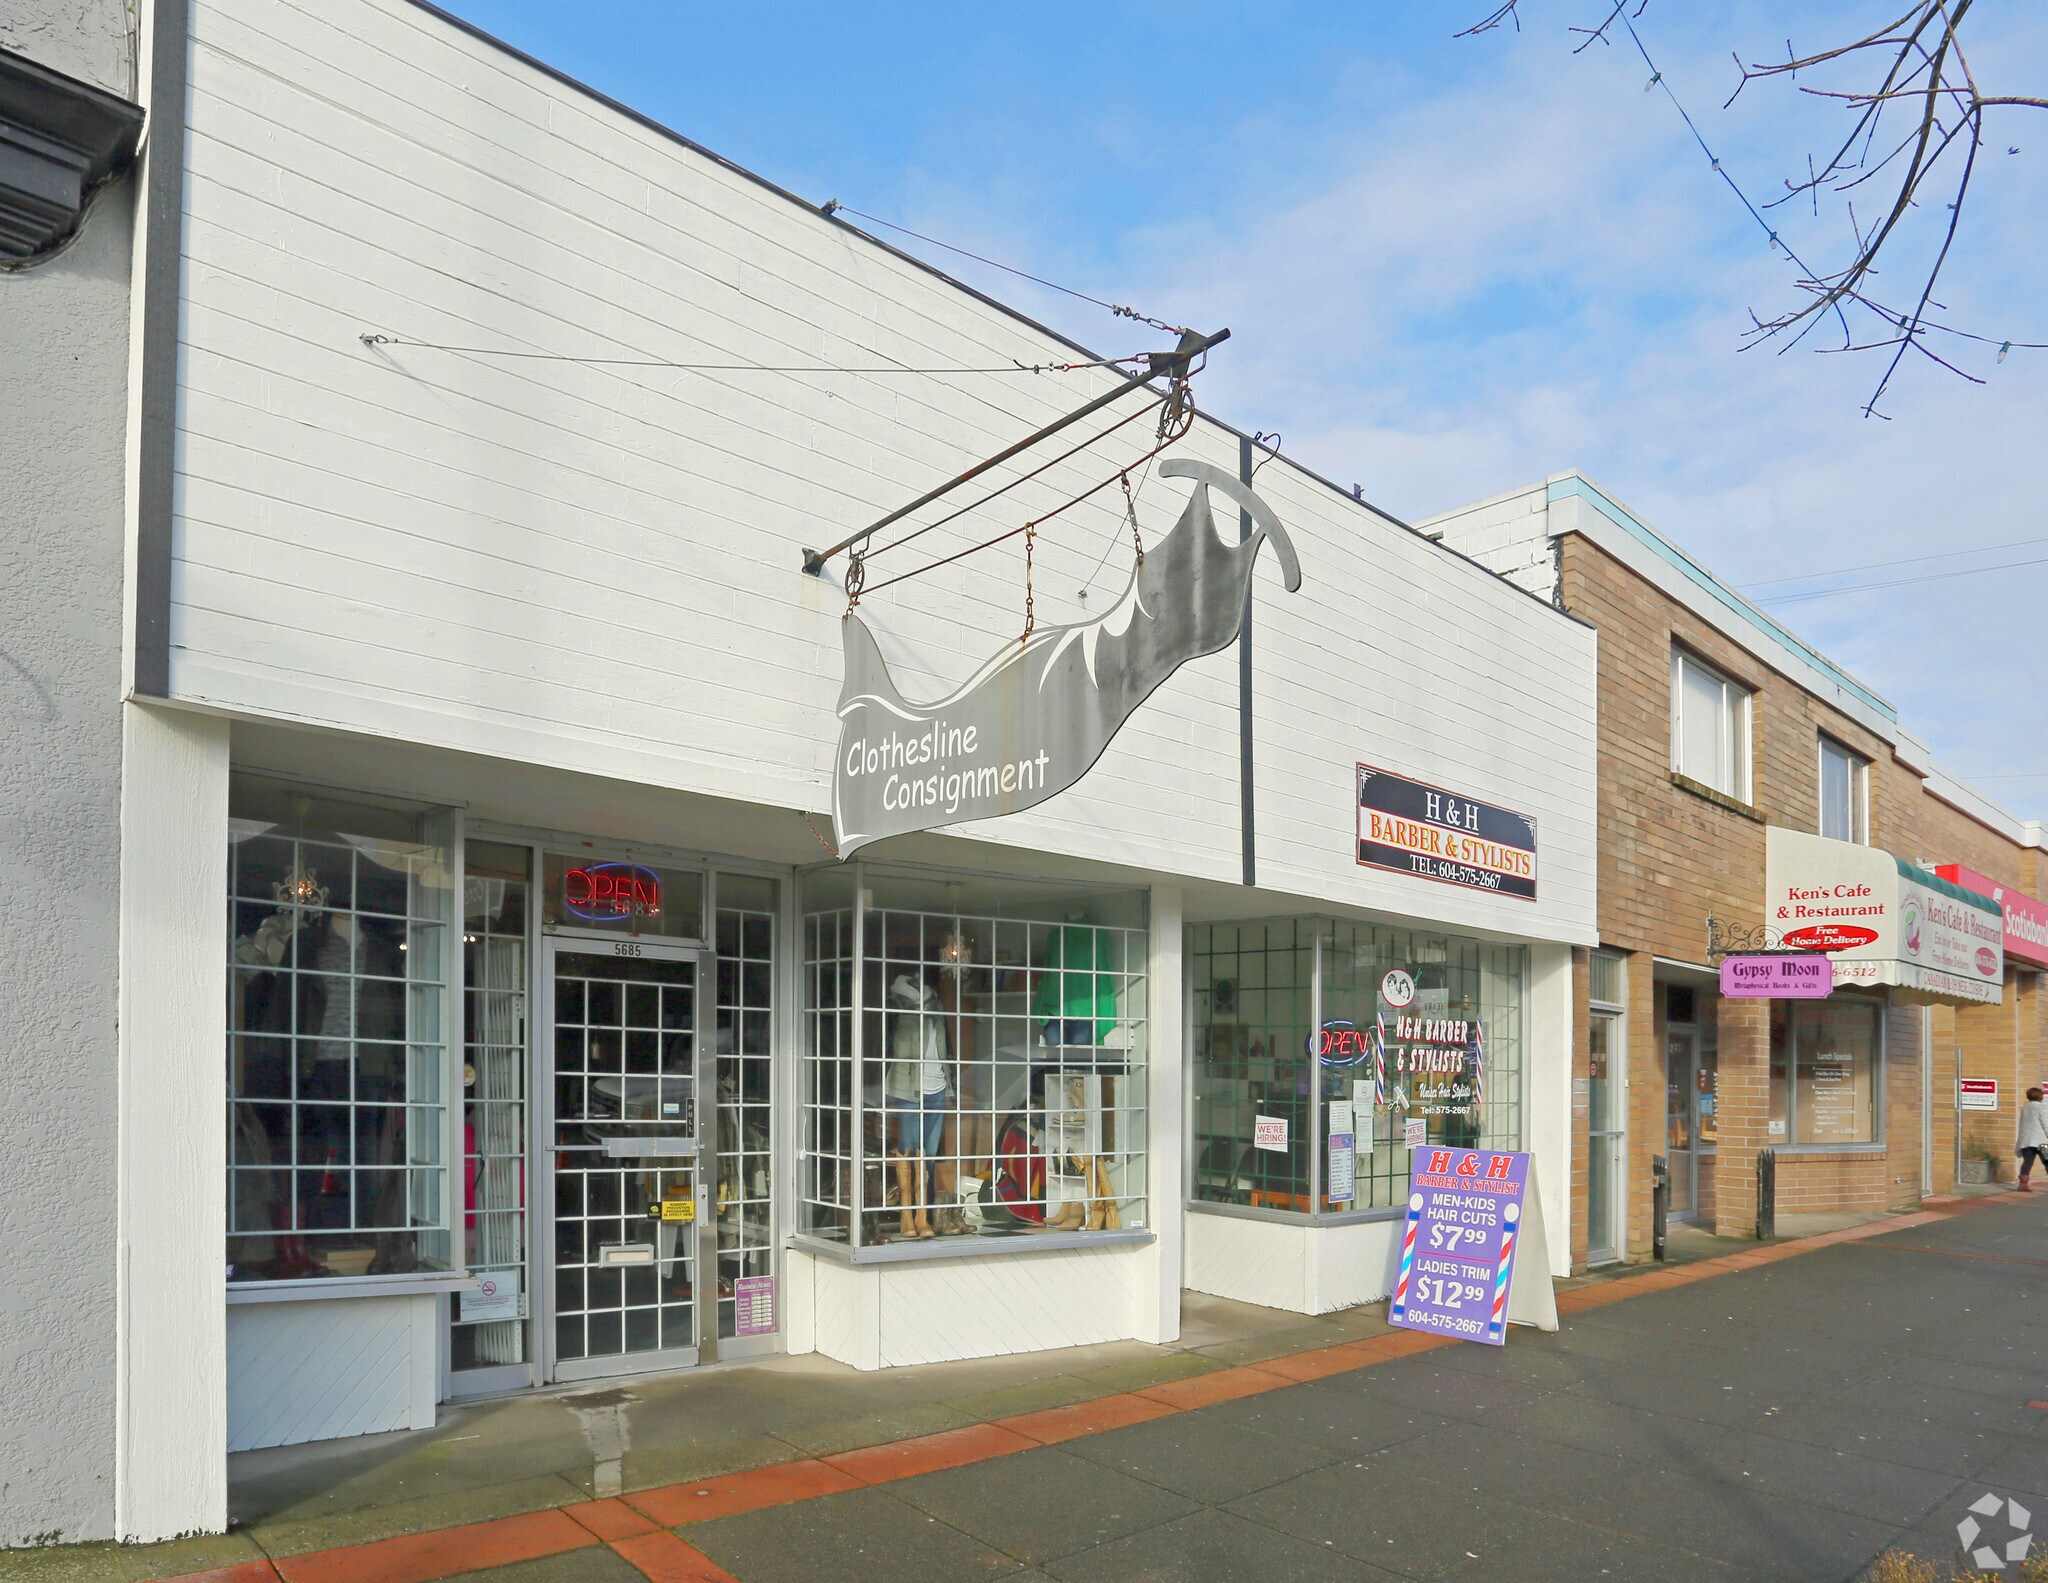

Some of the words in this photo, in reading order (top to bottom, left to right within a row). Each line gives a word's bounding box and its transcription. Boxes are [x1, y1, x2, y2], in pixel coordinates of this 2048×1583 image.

[846, 720, 978, 777] Clothesline
[883, 749, 1050, 814] Consignment
[1425, 791, 1441, 821] H
[1446, 799, 1461, 826] &
[1464, 803, 1479, 831] H
[1369, 813, 1442, 855] BARBER
[1445, 834, 1459, 859] &
[1461, 838, 1531, 876] STYLISTS
[1410, 854, 1437, 876] TEL:
[1439, 861, 1501, 889] 604-575-2667
[566, 869, 658, 911] OPEN
[1788, 886, 1830, 900] Ken's
[1834, 884, 1871, 898] Cafe
[1777, 906, 1790, 918] &
[1795, 903, 1884, 918] Restaurant
[1815, 926, 1839, 935] Free
[1927, 897, 1946, 926] Ken's
[1947, 904, 1962, 932] Cafe
[1963, 911, 1969, 934] &
[1970, 914, 2002, 945] Restaurant
[615, 943, 641, 956] 5685
[1791, 936, 1821, 945] Home
[1823, 936, 1867, 945] Delivery
[1732, 963, 1773, 980] Gypsy
[1781, 961, 1820, 977] Moon
[1734, 982, 1769, 991] Metaphysical
[1396, 1015, 1422, 1041] H&H
[1425, 1018, 1469, 1045] BARBER
[1321, 1030, 1369, 1054] OPEN
[1397, 1047, 1405, 1072] &
[1409, 1048, 1465, 1074] STYLISTS
[1817, 1052, 1832, 1060] Lunch
[1437, 1082, 1451, 1098] Hair
[1451, 1083, 1471, 1102] Stylists
[1420, 1106, 1434, 1114] Tel:
[1435, 1106, 1471, 1114] 575-2667
[1256, 1133, 1287, 1142] HIRING!
[1257, 1125, 1284, 1134] WE'RE
[1406, 1132, 1425, 1142] HIRING!
[1407, 1124, 1424, 1135] WE'RE
[1427, 1150, 1454, 1174] H
[1456, 1153, 1481, 1177] &
[1486, 1155, 1514, 1179] H
[1416, 1174, 1458, 1189] BARBER
[1461, 1179, 1471, 1191] &
[1473, 1180, 1520, 1195] STYLIST
[1432, 1193, 1497, 1211] MEN-KIDS
[1427, 1207, 1457, 1222] HAIR
[1461, 1211, 1497, 1226] CUTS
[1417, 1258, 1458, 1277] LADIES
[1462, 1265, 1491, 1281] TRIM
[1408, 1309, 1485, 1335] 604-575-2667
